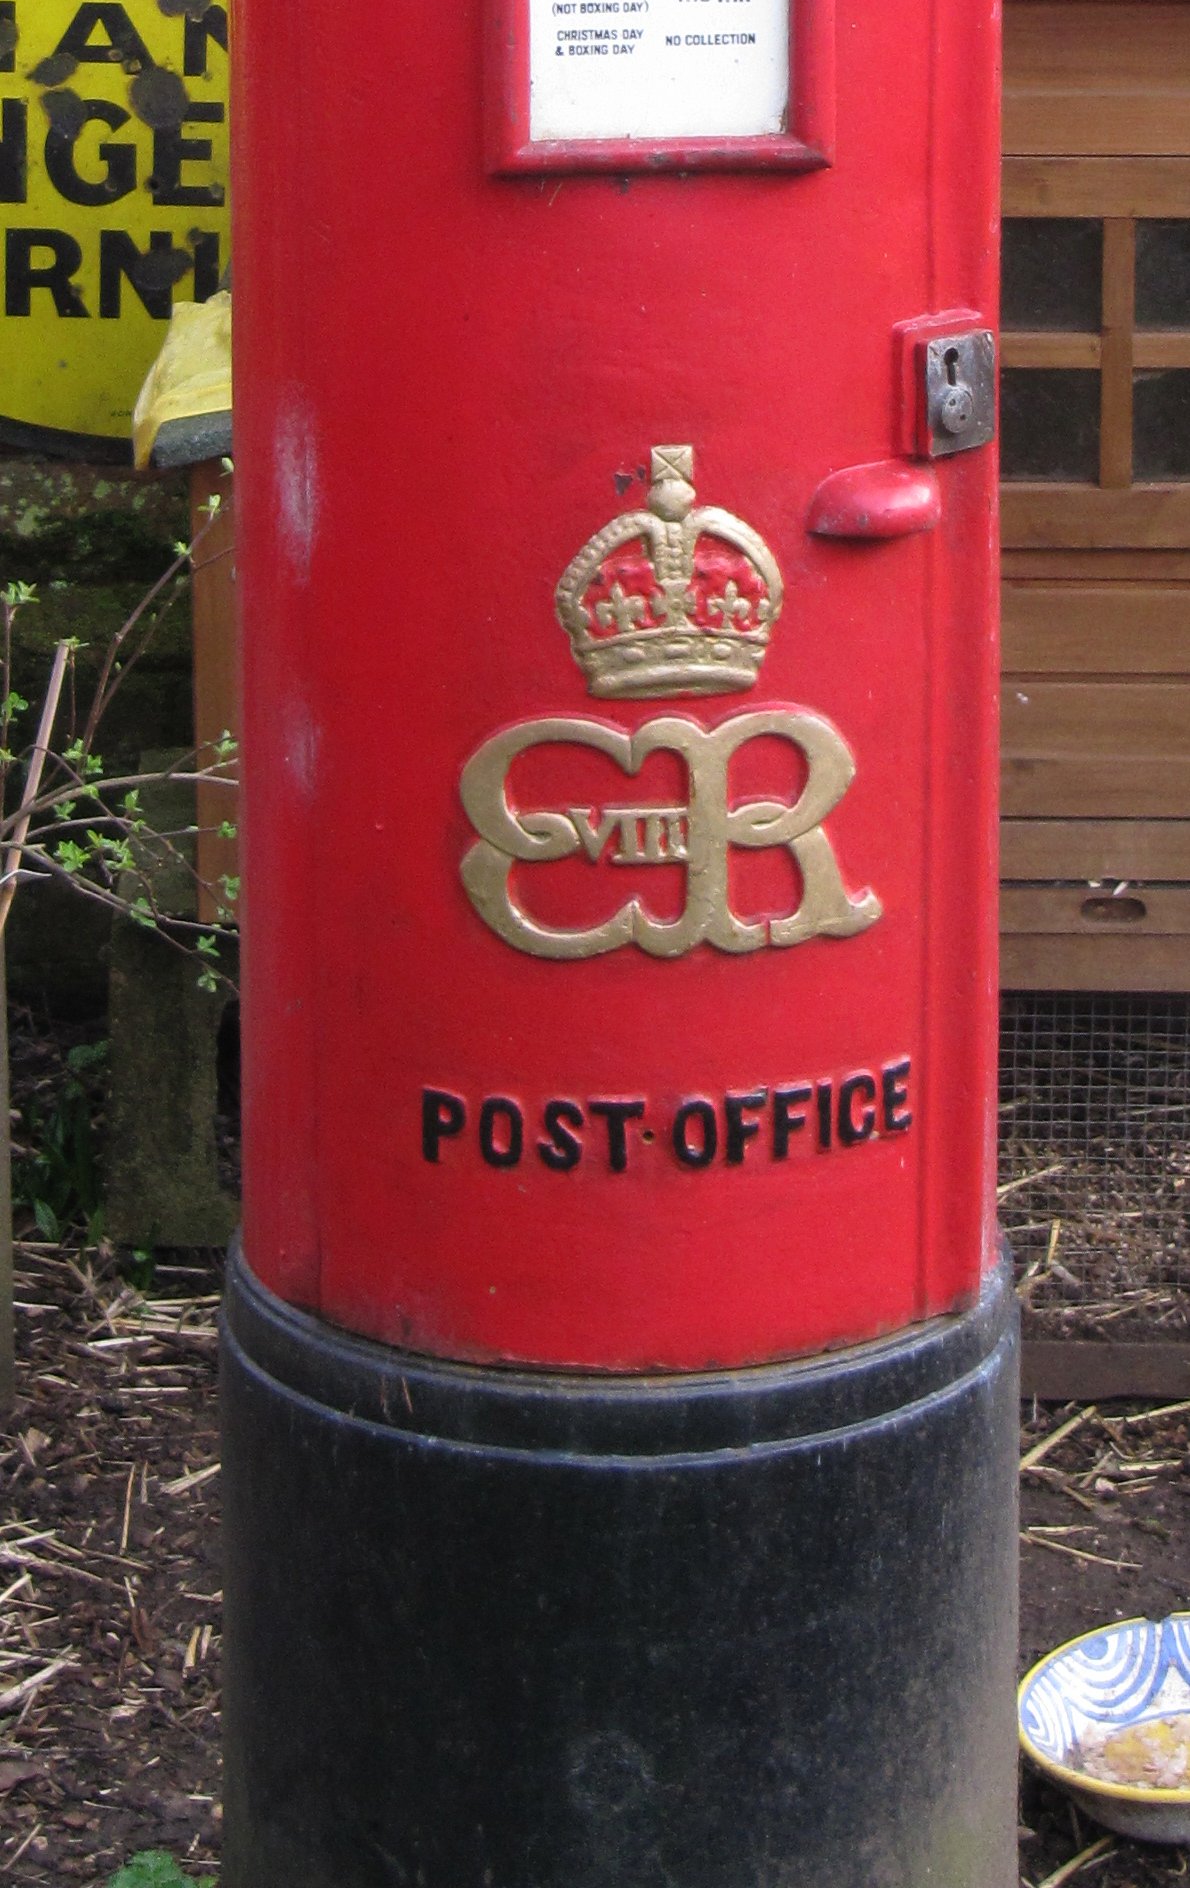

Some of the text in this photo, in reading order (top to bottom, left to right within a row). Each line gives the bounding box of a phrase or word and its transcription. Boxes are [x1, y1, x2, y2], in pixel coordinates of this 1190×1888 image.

[552, 0, 649, 16] (NOT BOXING DAY)
[556, 28, 645, 42] CHRISTMAS DAY
[665, 33, 756, 46] NO COLLECTION
[555, 44, 635, 56] & BOXING DAY
[420, 1056, 914, 1173] POST OFFICE
